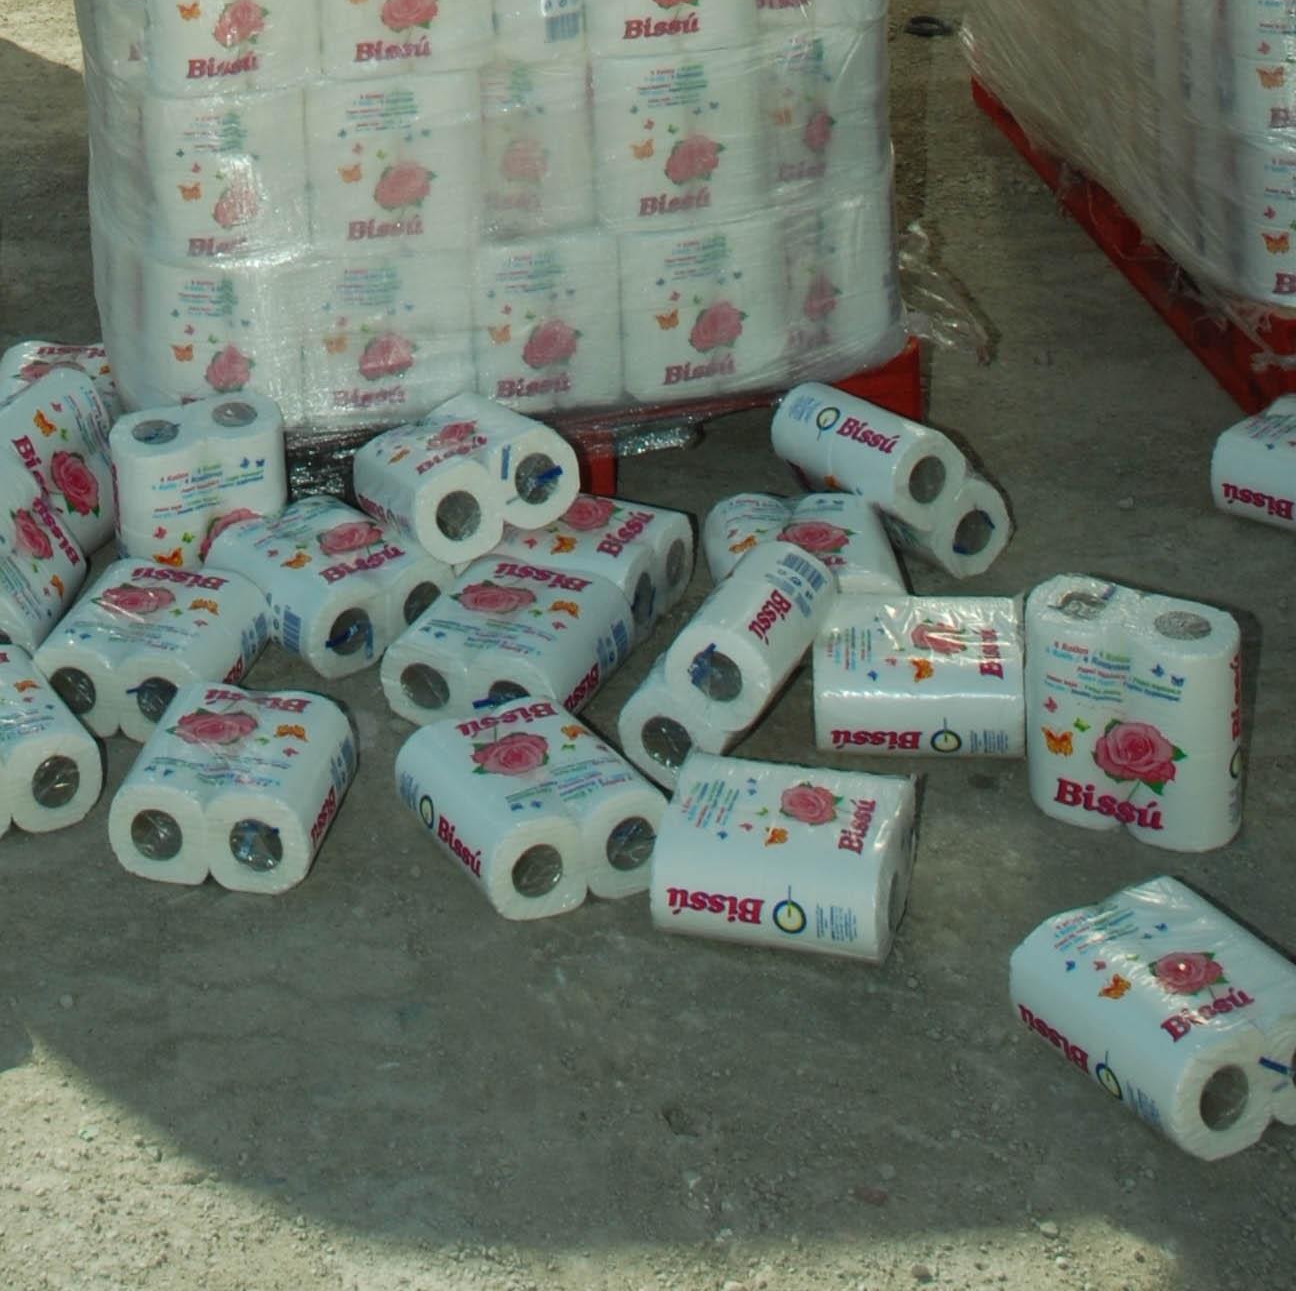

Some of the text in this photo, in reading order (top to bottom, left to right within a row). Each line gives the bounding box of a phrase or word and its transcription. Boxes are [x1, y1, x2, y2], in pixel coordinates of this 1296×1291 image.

[838, 417, 899, 453] Bissú
[832, 730, 919, 750] Bissú
[1054, 778, 1163, 830] Bissú
[667, 887, 762, 923] Bissú
